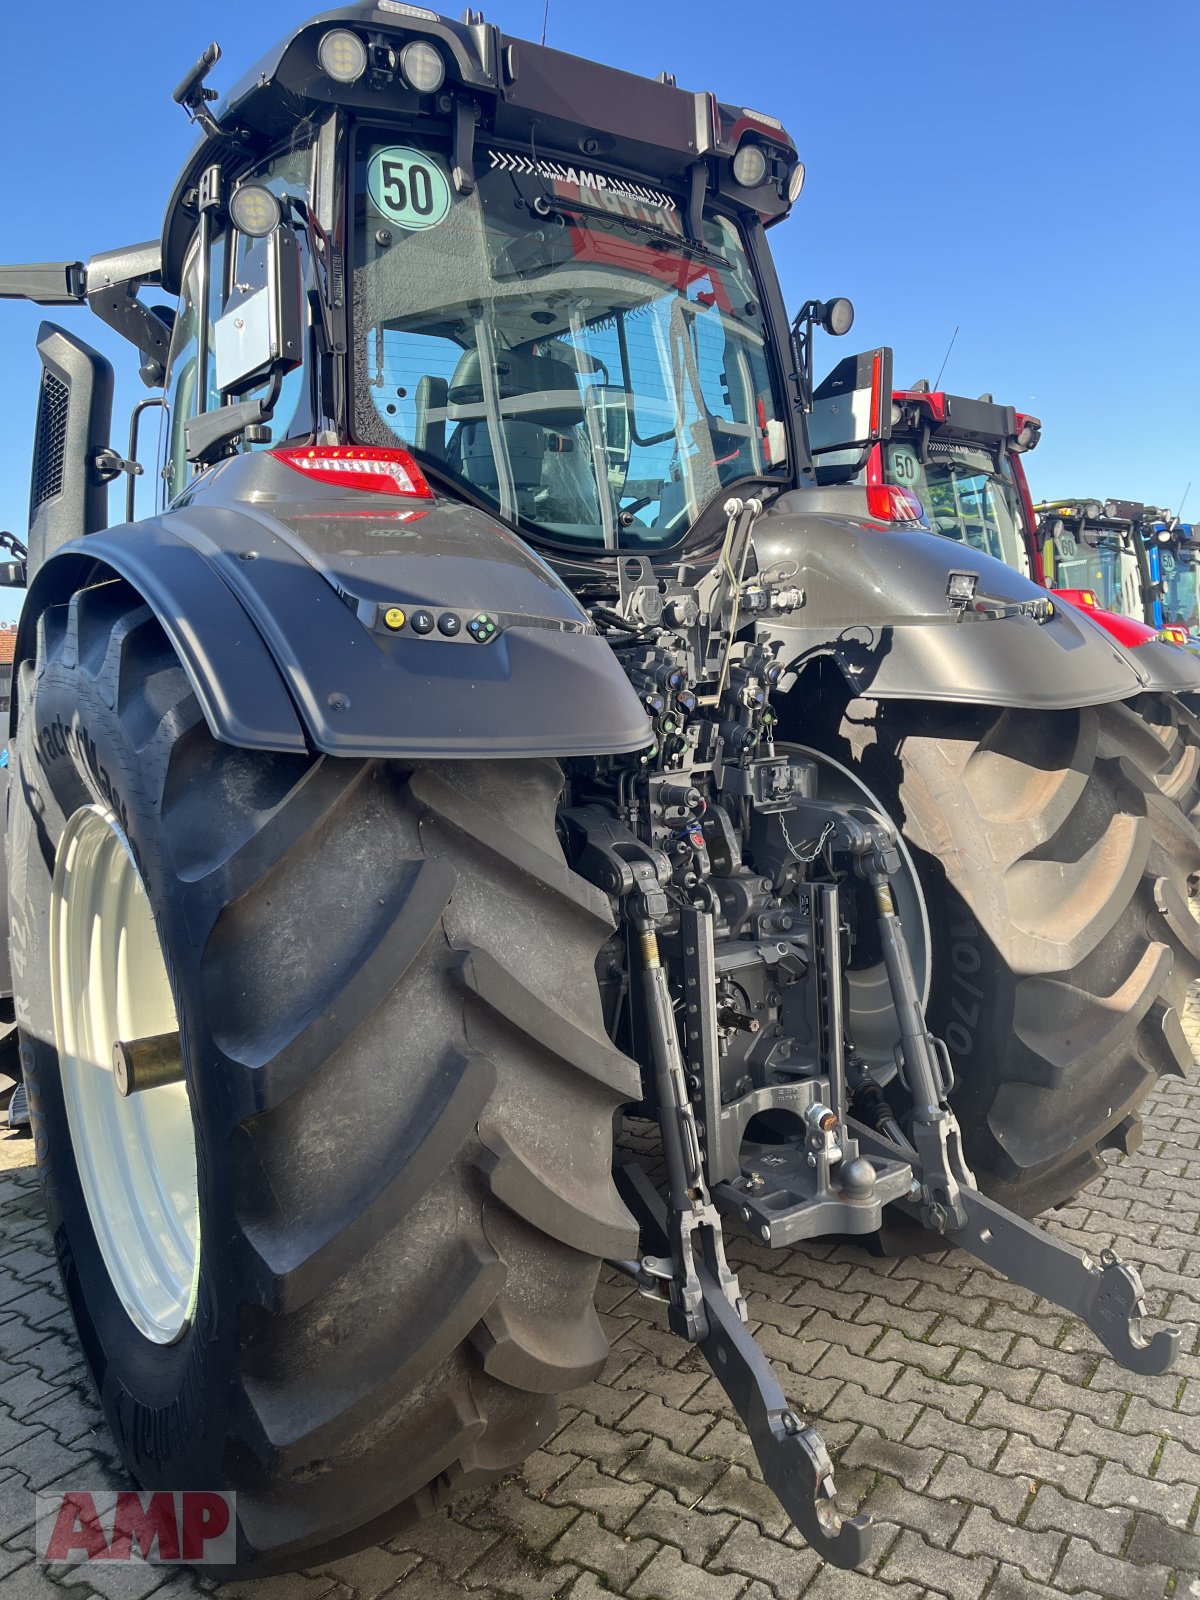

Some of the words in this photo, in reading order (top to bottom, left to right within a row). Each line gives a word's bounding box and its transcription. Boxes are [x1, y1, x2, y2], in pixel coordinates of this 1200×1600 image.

[381, 160, 434, 216] 50
[894, 456, 914, 480] 50
[1061, 540, 1075, 556] 60
